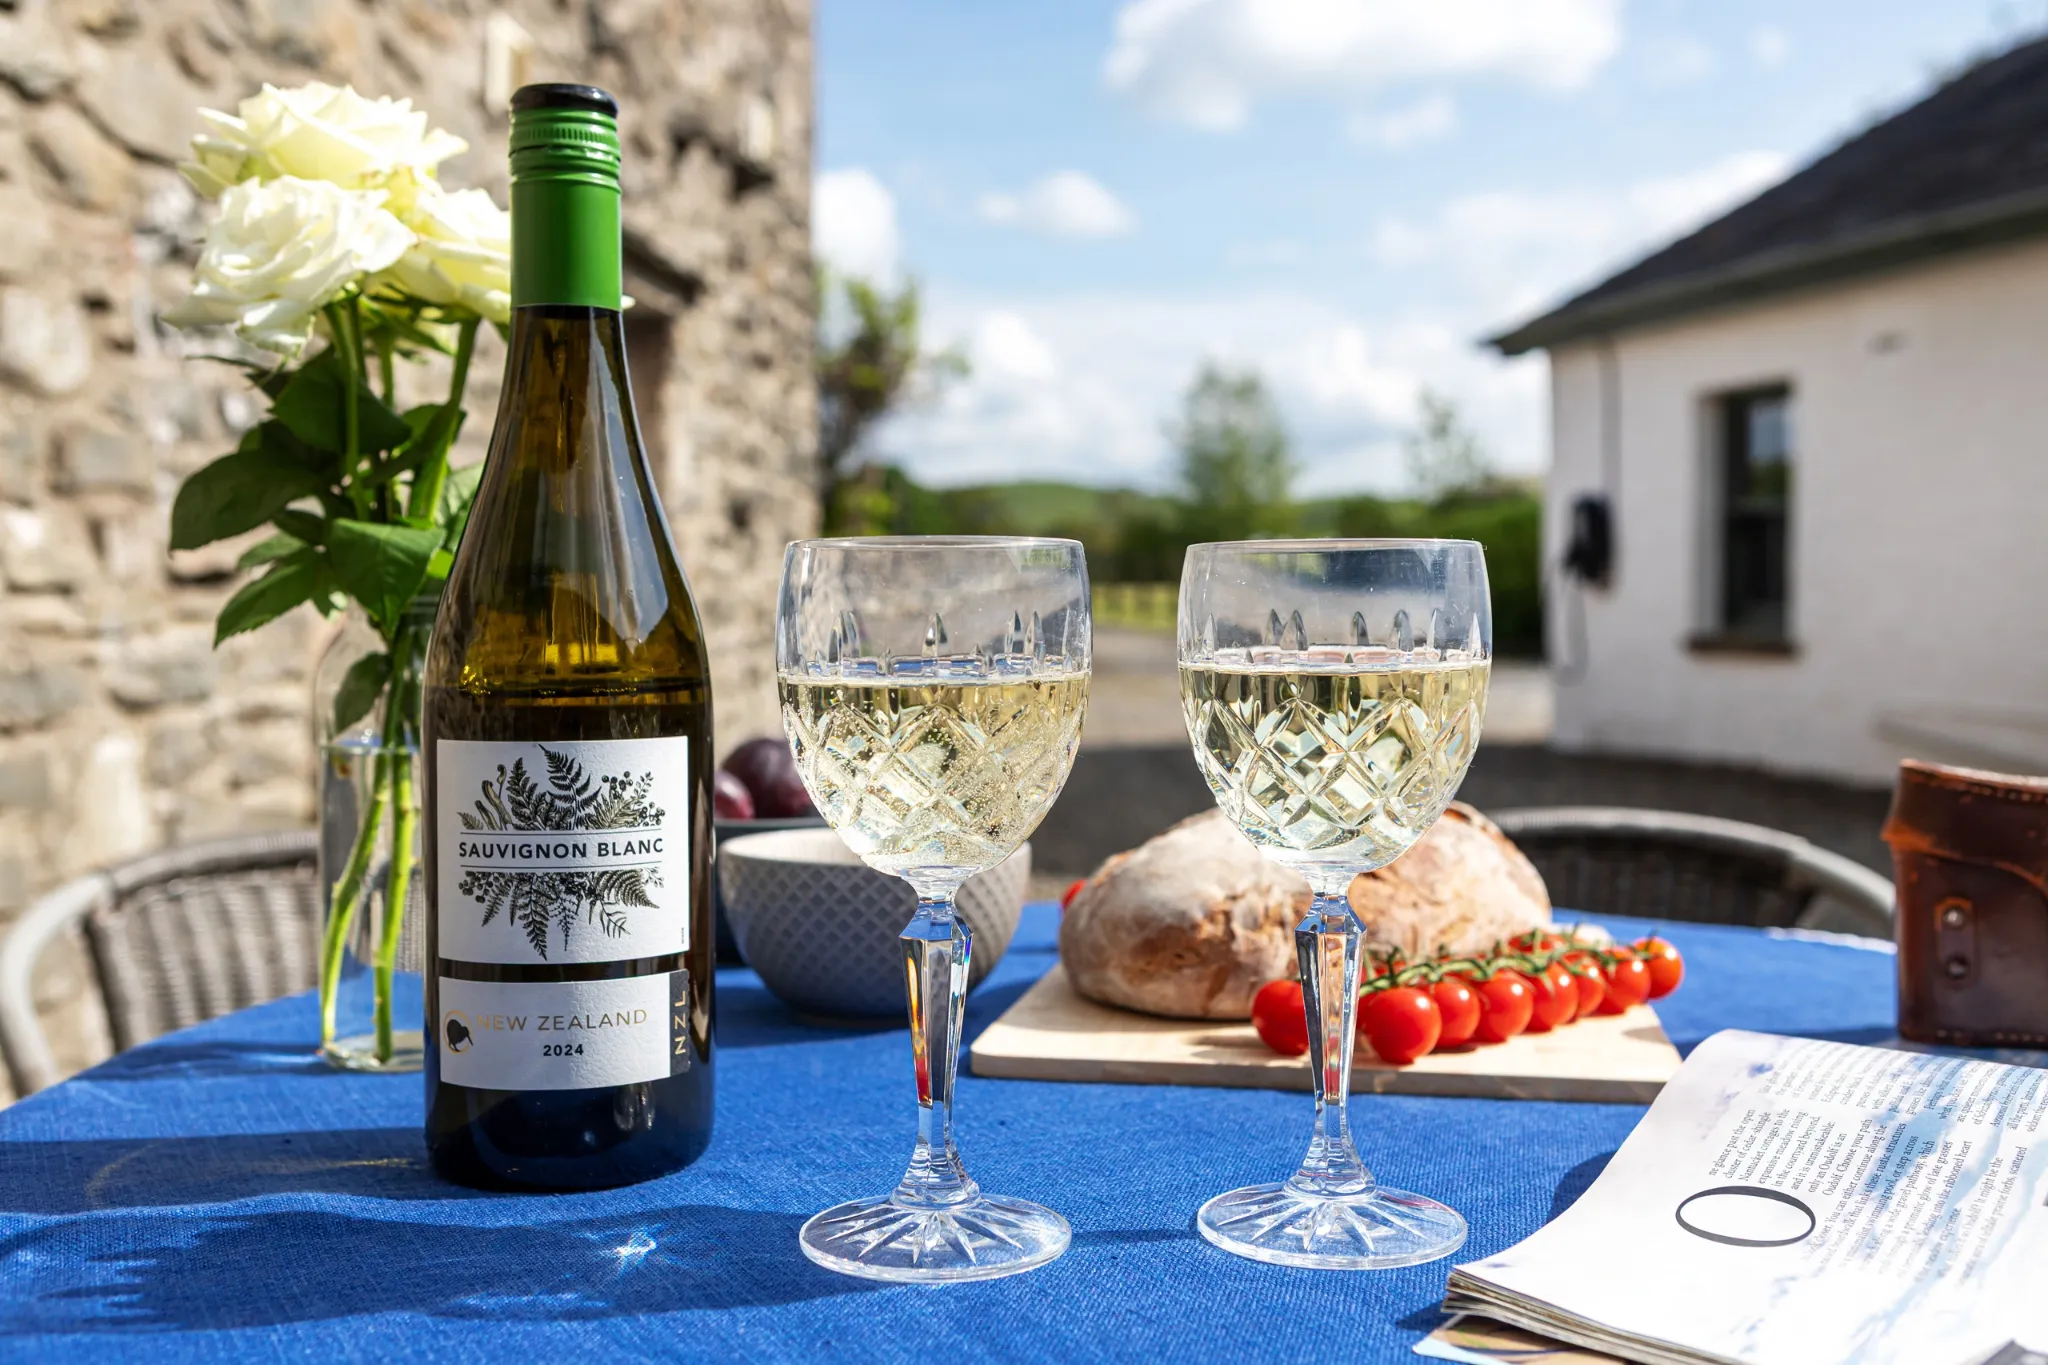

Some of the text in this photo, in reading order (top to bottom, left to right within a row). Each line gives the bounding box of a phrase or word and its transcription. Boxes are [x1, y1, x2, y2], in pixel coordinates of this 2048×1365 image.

[458, 837, 665, 860] SAUVIGNON BLANC
[475, 1009, 649, 1031] NEW ZEALAND
[674, 990, 688, 1056] NZL
[542, 1043, 585, 1057] 2024
[1837, 1133, 1847, 1141] an
[1874, 1124, 1887, 1135] the
[1713, 1149, 1731, 1168] glance
[1727, 1135, 1739, 1149] past
[1733, 1125, 1746, 1135] the
[1740, 1109, 1758, 1124] open
[1739, 1151, 1765, 1181] Nantucket
[1761, 1127, 1779, 1150] cottages
[1777, 1109, 1790, 1118] the
[1865, 1136, 1885, 1153] along
[1886, 1124, 1906, 1153] structures
[1903, 1136, 1918, 1155] across
[1758, 1112, 1809, 1184] expansive meadow rising
[1937, 1142, 1953, 1164] grasses
[1955, 1141, 1972, 1158] heart
[1723, 1159, 1742, 1178] cluster
[1737, 1150, 1747, 1158] of
[1777, 1170, 1790, 1179] the
[1786, 1140, 1807, 1169] courtyard
[1819, 1147, 1839, 1170] Oudolf
[1822, 1118, 1874, 1196] Oudolf. Choose your path
[1877, 1154, 1891, 1172] rustic
[1896, 1156, 1912, 1169] step
[1987, 1158, 2003, 1168] the
[2006, 1145, 2028, 1174] scattered
[1817, 1171, 1826, 1179] an
[1853, 1154, 1872, 1181] continue
[1893, 1170, 1903, 1178] or
[1927, 1165, 1943, 1177] late
[1943, 1158, 1964, 1188] ribboned
[1985, 1167, 1999, 1177] be
[1791, 1177, 1803, 1190] and
[1808, 1179, 1824, 1193] only
[1865, 1173, 1881, 1189] these
[1883, 1179, 1899, 1195] pool,
[1888, 1209, 1901, 1223] wide
[1896, 1189, 1911, 1208] gravel
[1906, 1162, 1927, 1189] pathway,
[1918, 1141, 1935, 1159] which
[1925, 1176, 1937, 1185] of
[1976, 1177, 1998, 1197] might
[1999, 1177, 2016, 1194] forbs,
[1843, 1181, 1858, 1199] either
[1855, 1189, 1873, 1205] links
[1917, 1186, 1932, 1201] glow
[1938, 1189, 1951, 1199] the
[1836, 1201, 1847, 1211] can
[1848, 1205, 1864, 1217] that
[1934, 1200, 1946, 1213] into
[1825, 1212, 1841, 1223] You
[1904, 1201, 1925, 1230] prismatic
